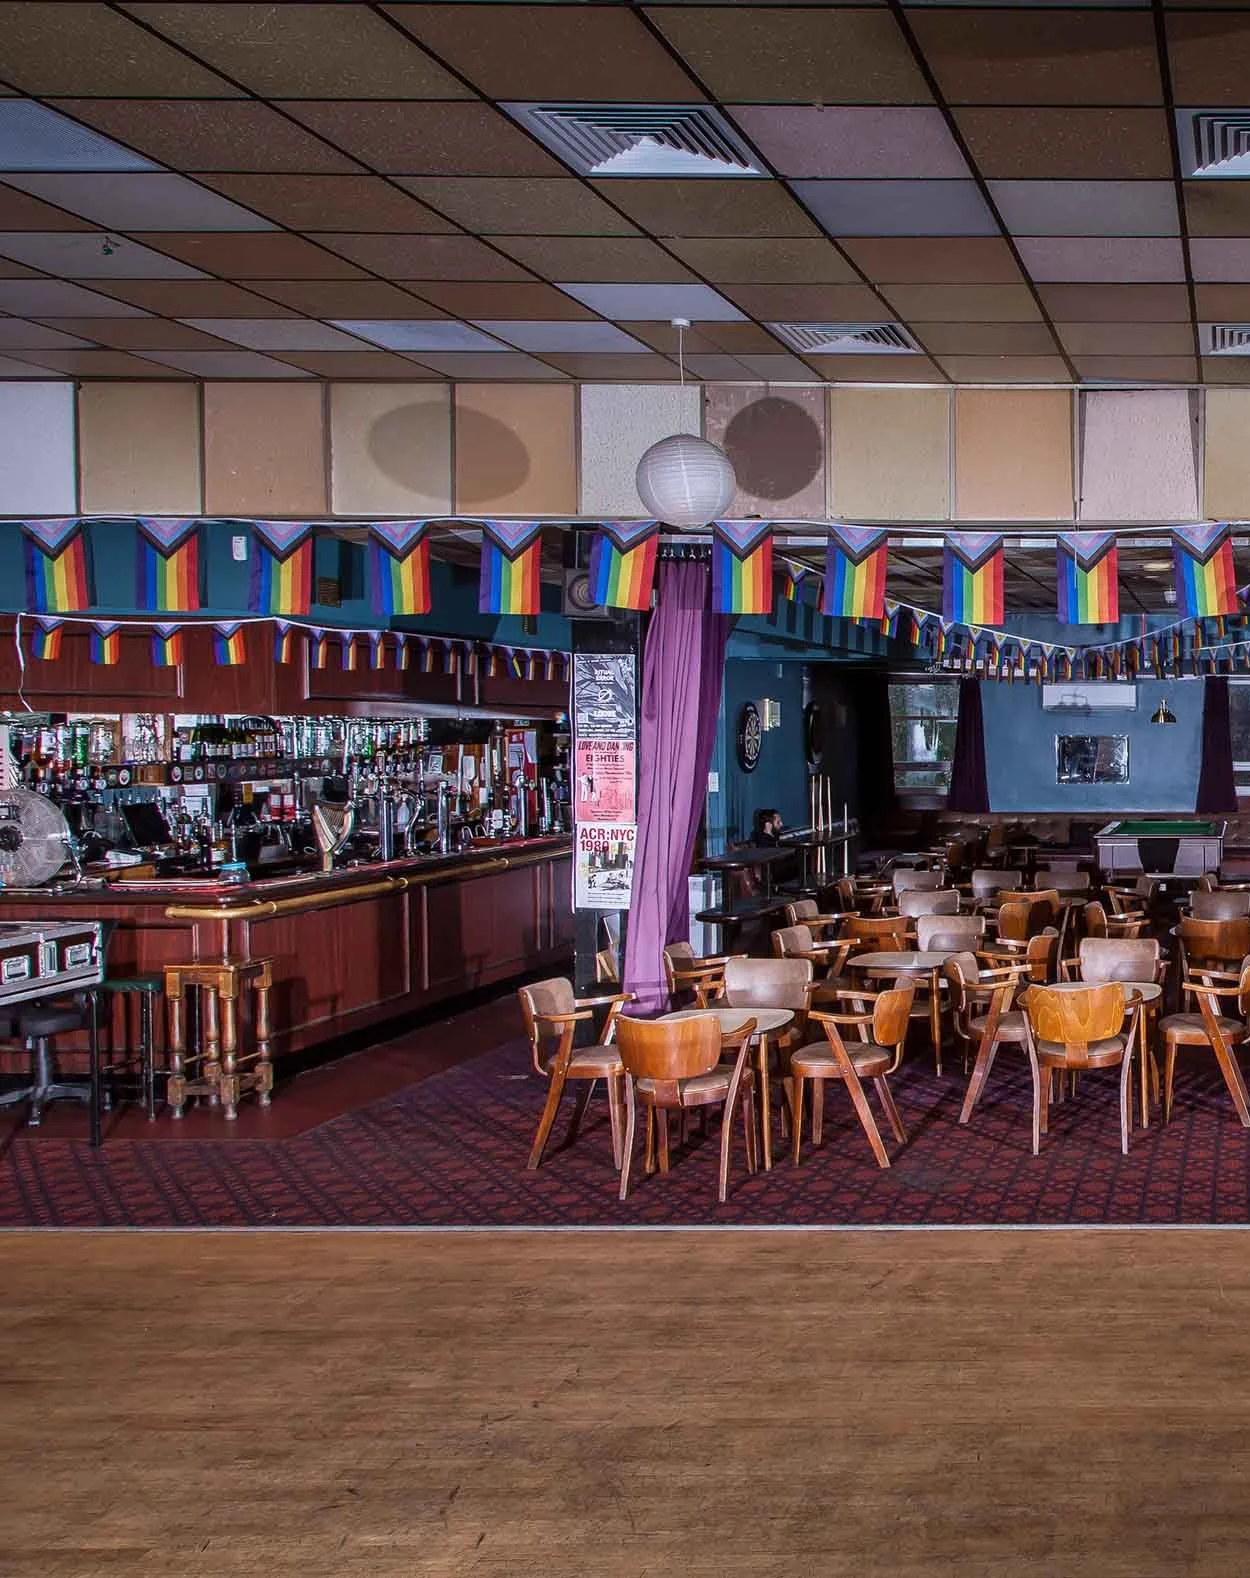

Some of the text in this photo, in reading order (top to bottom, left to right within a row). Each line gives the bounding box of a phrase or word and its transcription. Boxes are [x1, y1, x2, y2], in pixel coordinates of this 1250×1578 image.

[578, 741, 634, 752] LOVE AND DANING
[585, 754, 625, 763] EIGHTIES
[580, 827, 635, 841] ACR:NYC
[580, 839, 610, 852] 1980
